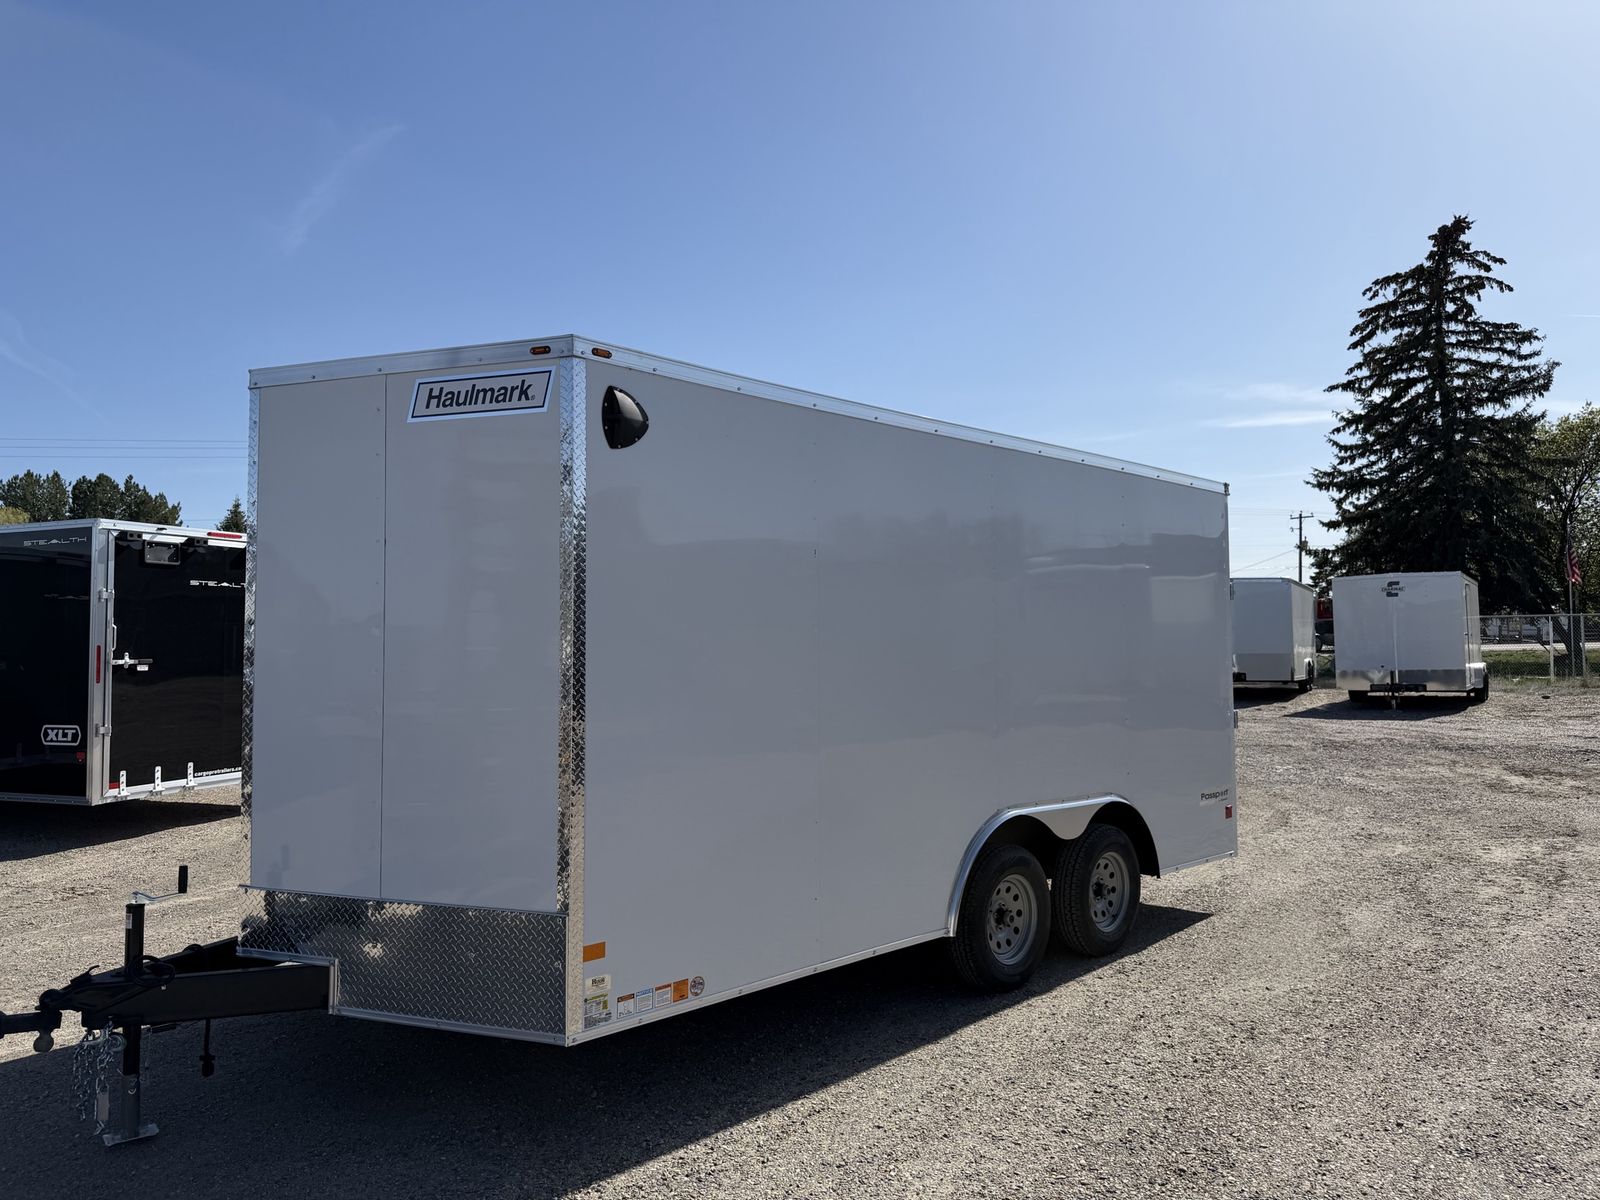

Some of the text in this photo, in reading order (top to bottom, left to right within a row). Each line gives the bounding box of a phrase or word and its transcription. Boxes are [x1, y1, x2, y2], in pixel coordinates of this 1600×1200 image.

[425, 379, 534, 410] Haulmark
[23, 536, 87, 547] STEALTH
[190, 580, 246, 588] STEALT
[46, 729, 77, 741] XLT
